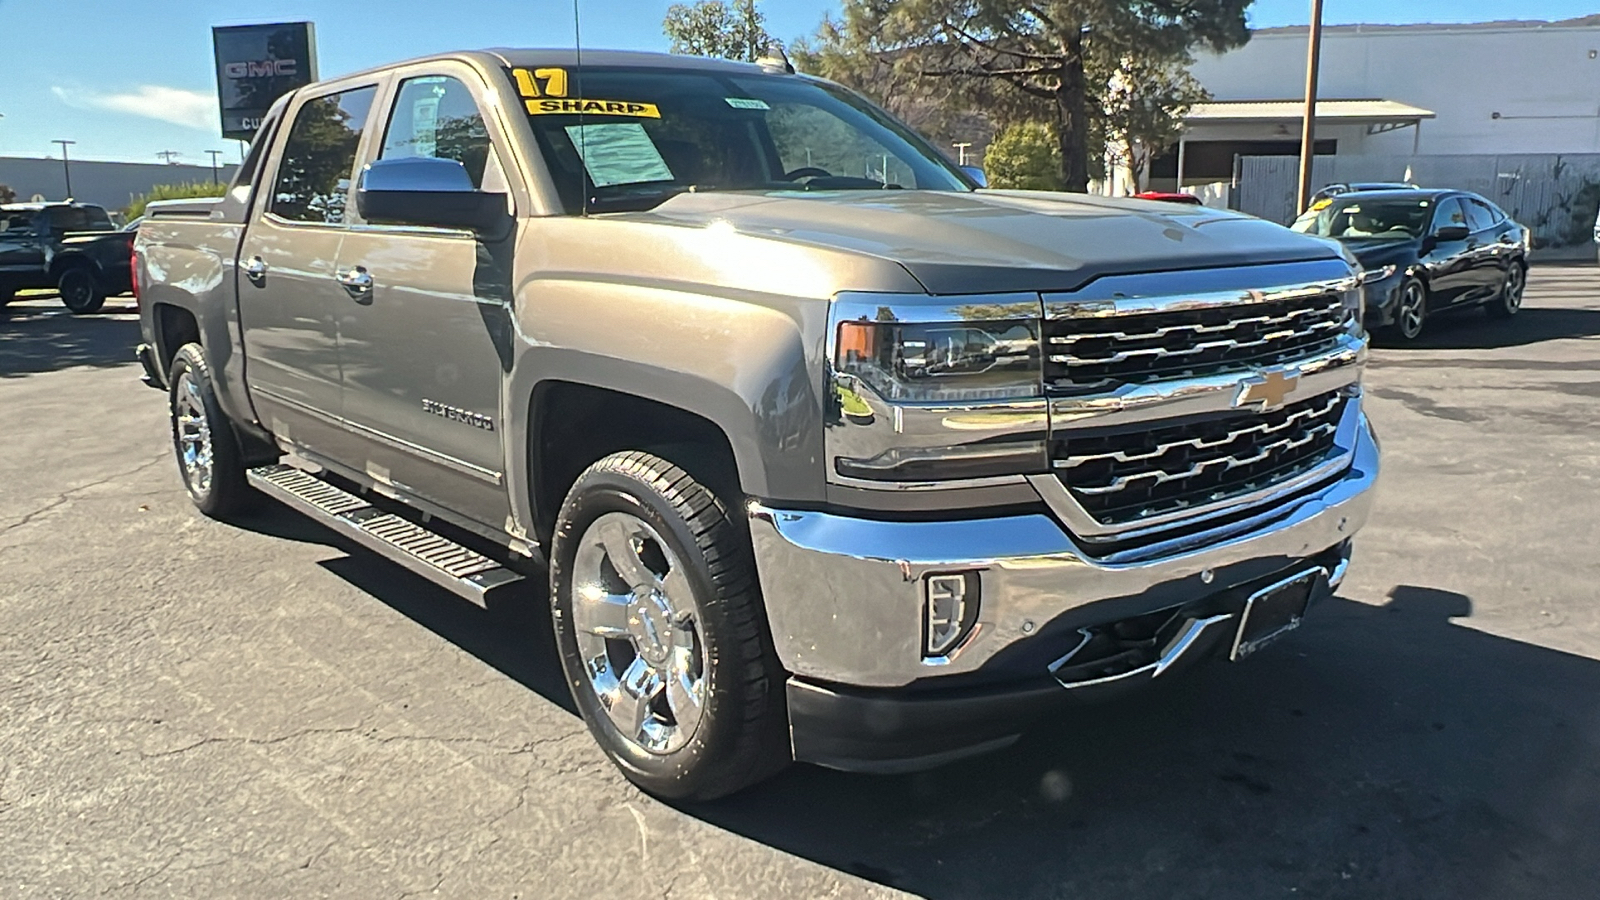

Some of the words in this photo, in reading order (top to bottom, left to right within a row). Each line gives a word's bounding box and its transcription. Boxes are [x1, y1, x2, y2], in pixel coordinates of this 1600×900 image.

[225, 59, 297, 78] GMC
[512, 68, 567, 97] 17
[539, 101, 648, 114] SHARP
